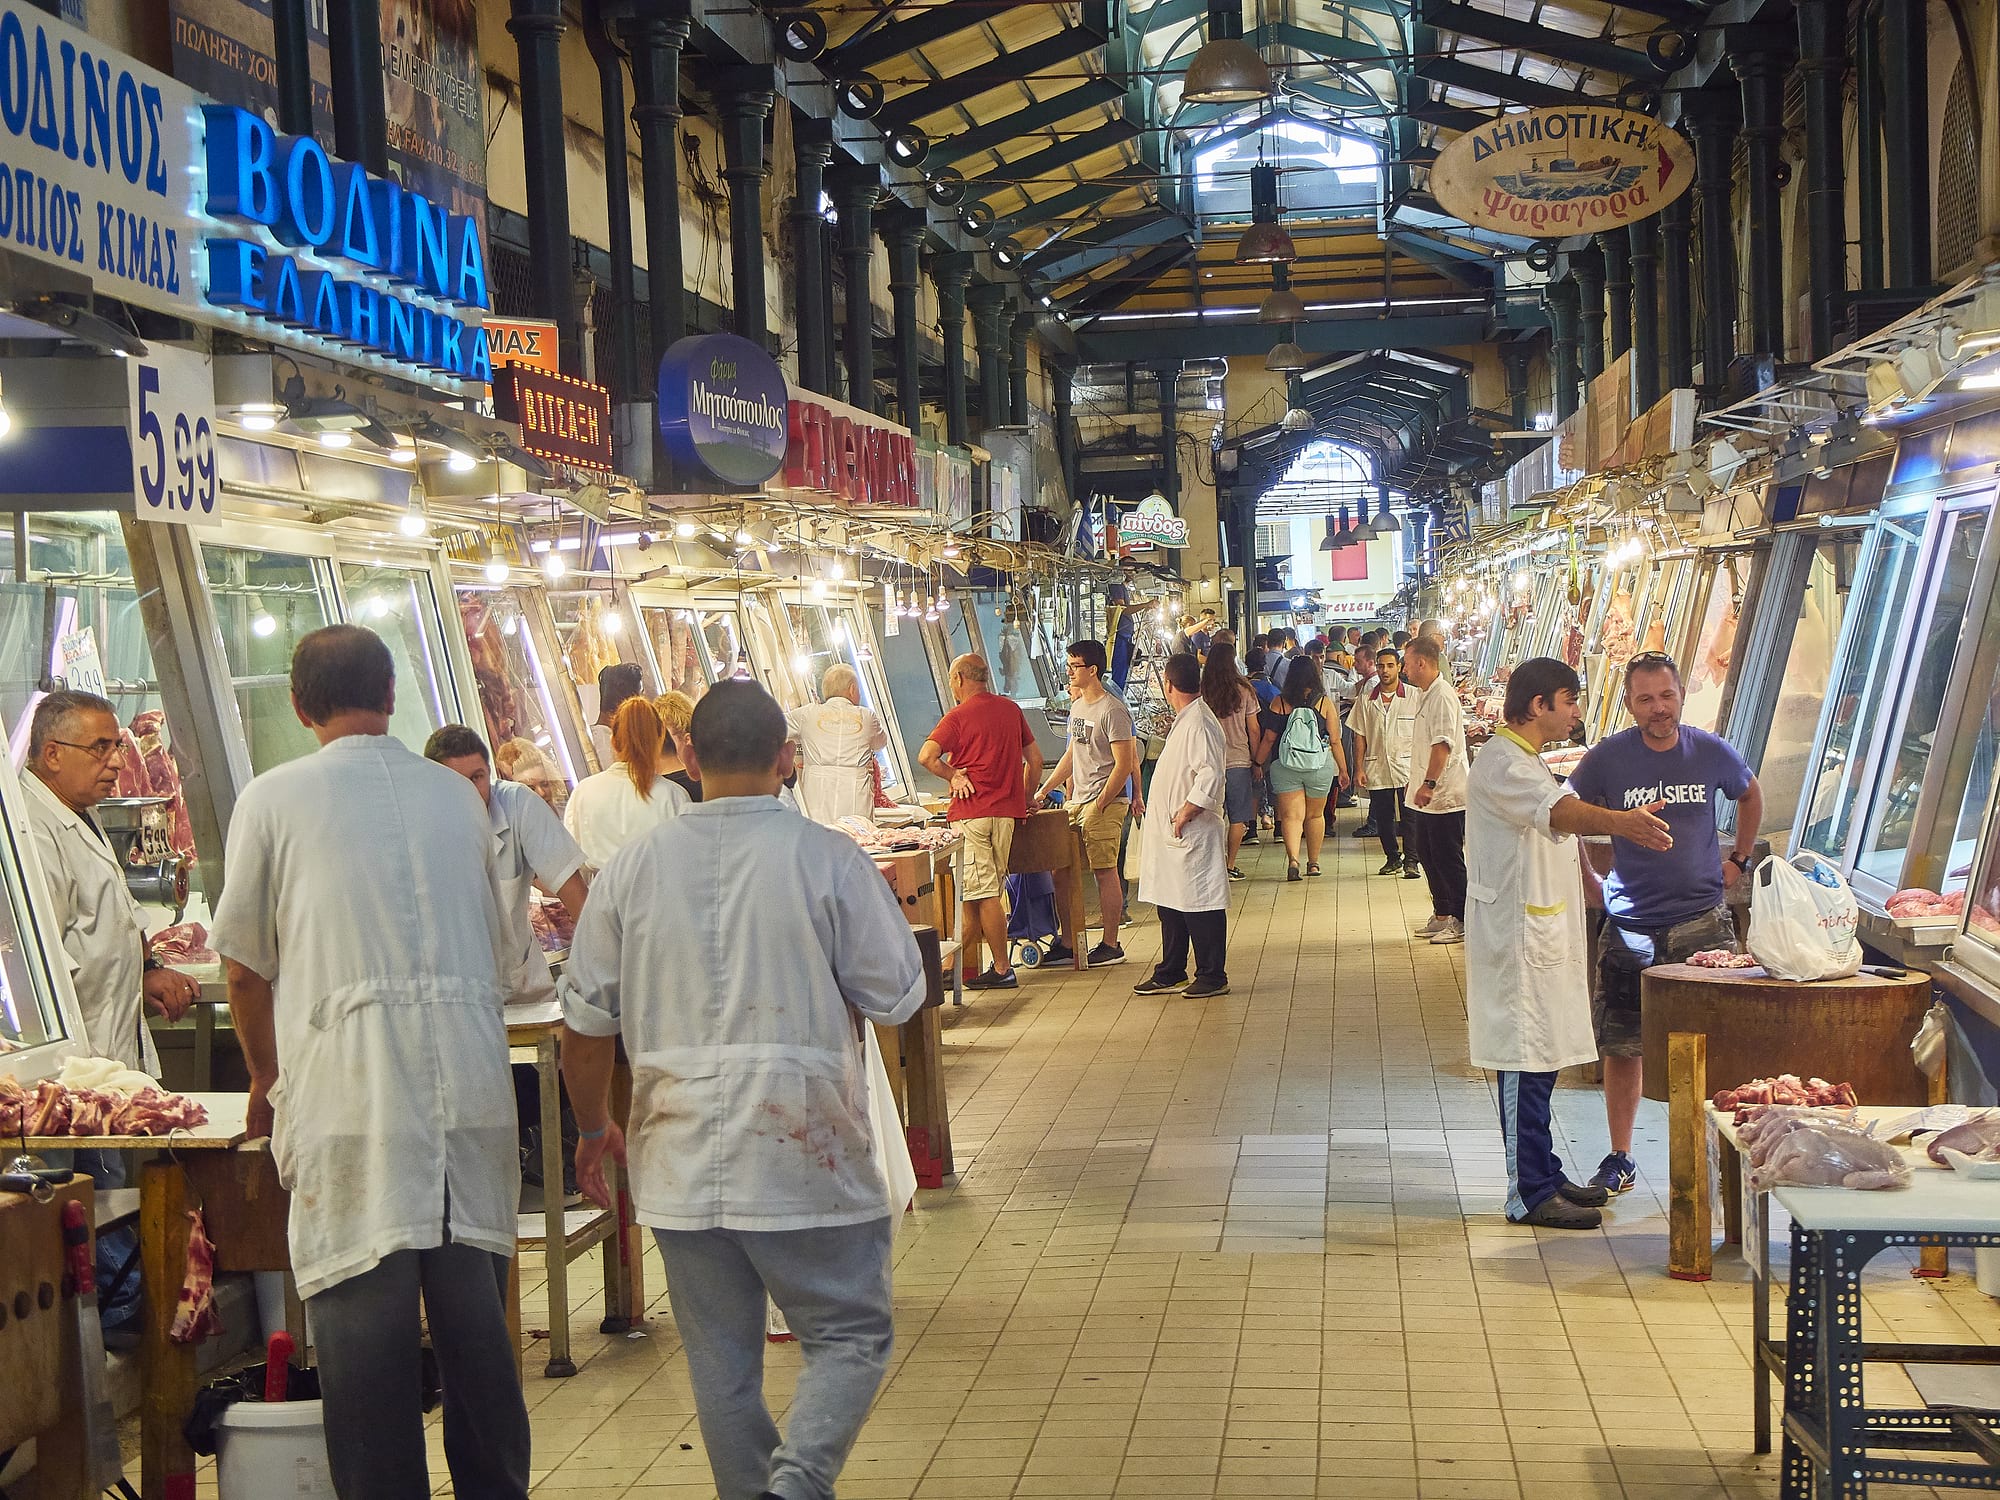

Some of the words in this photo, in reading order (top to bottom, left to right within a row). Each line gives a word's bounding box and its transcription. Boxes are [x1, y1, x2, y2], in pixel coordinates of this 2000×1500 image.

[175, 17, 244, 71] ΠΩΛΗΣΗ:
[247, 51, 279, 89] ΧΟΝ
[1472, 113, 1650, 163] ΔΗΜΟΤΙΚΗ
[228, 105, 490, 310] ΒΟΔΙΝΑ
[1482, 180, 1650, 231] Ψαραγορά
[97, 200, 180, 296] ΚΙΜΑΣ
[232, 239, 493, 383] ΕΛΛΗΝΙΚΑ
[138, 364, 216, 514] 5.99
[525, 388, 600, 446] ΒΙΤΣΑΞΗ
[692, 380, 783, 440] Μητσόπουλος
[1123, 512, 1185, 540] πίνδος
[1664, 784, 1707, 804] SIEGE
